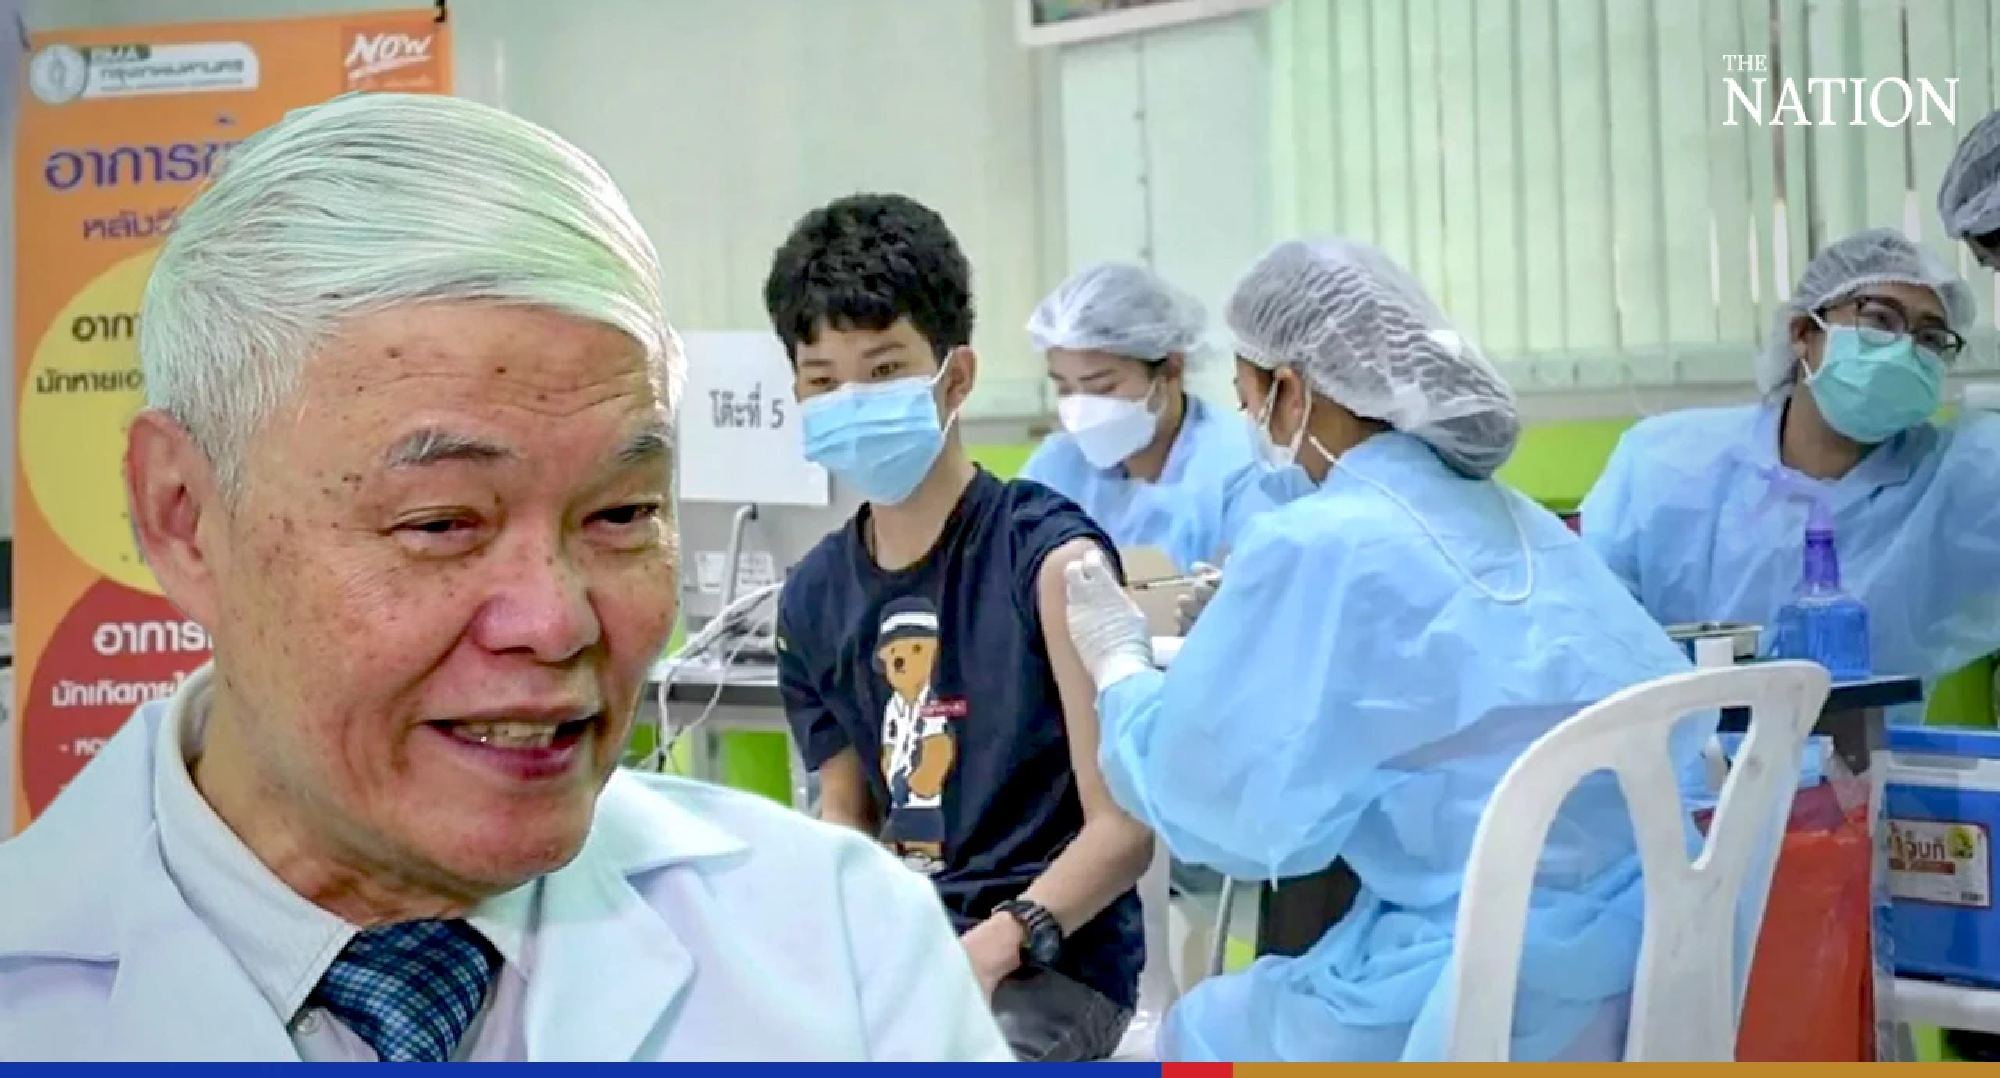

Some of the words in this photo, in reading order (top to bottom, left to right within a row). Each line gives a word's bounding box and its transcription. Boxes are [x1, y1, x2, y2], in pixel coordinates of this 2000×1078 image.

[708, 381, 761, 429] โต๊ะที่
[770, 398, 784, 430] 5
[93, 620, 213, 655] อาการ
